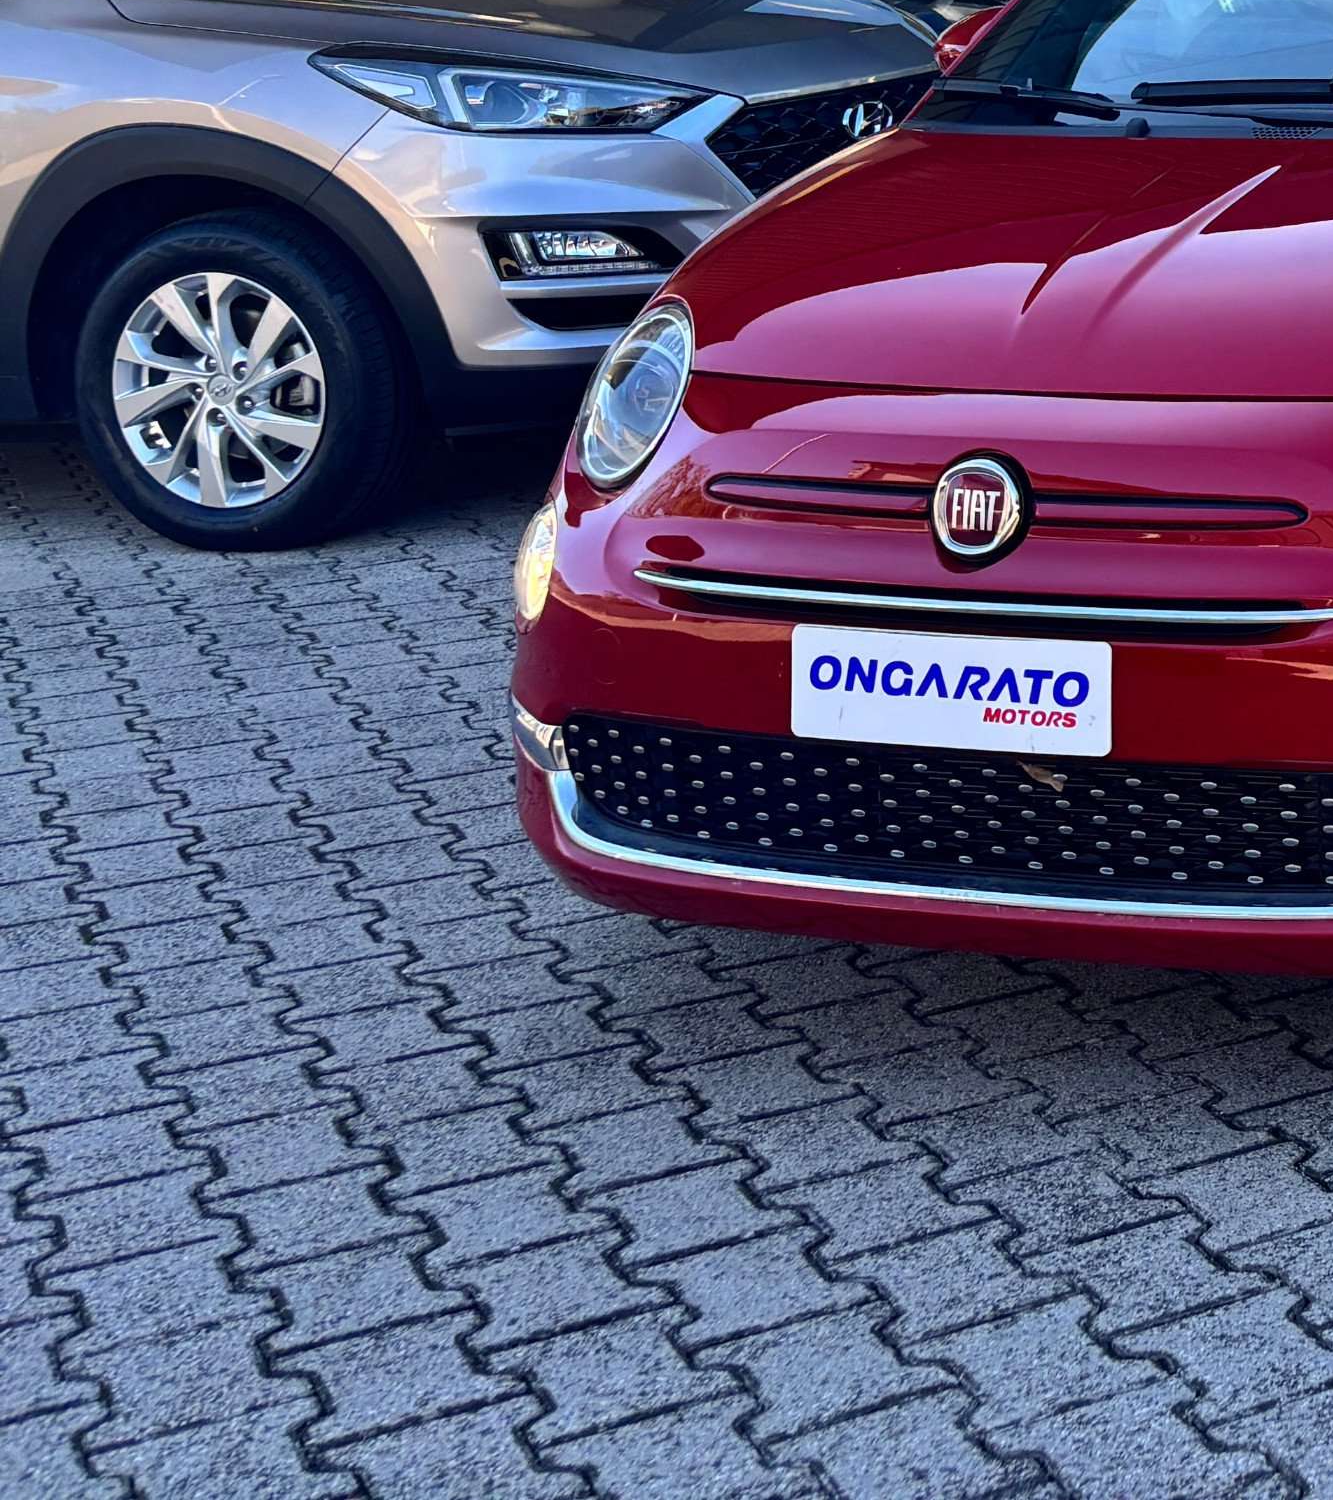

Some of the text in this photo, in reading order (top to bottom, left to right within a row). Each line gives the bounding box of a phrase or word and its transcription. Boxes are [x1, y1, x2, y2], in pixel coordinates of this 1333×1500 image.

[951, 488, 1001, 531] FIAT
[809, 654, 1090, 708] ONGARATO
[982, 707, 1078, 729] MOTORS
